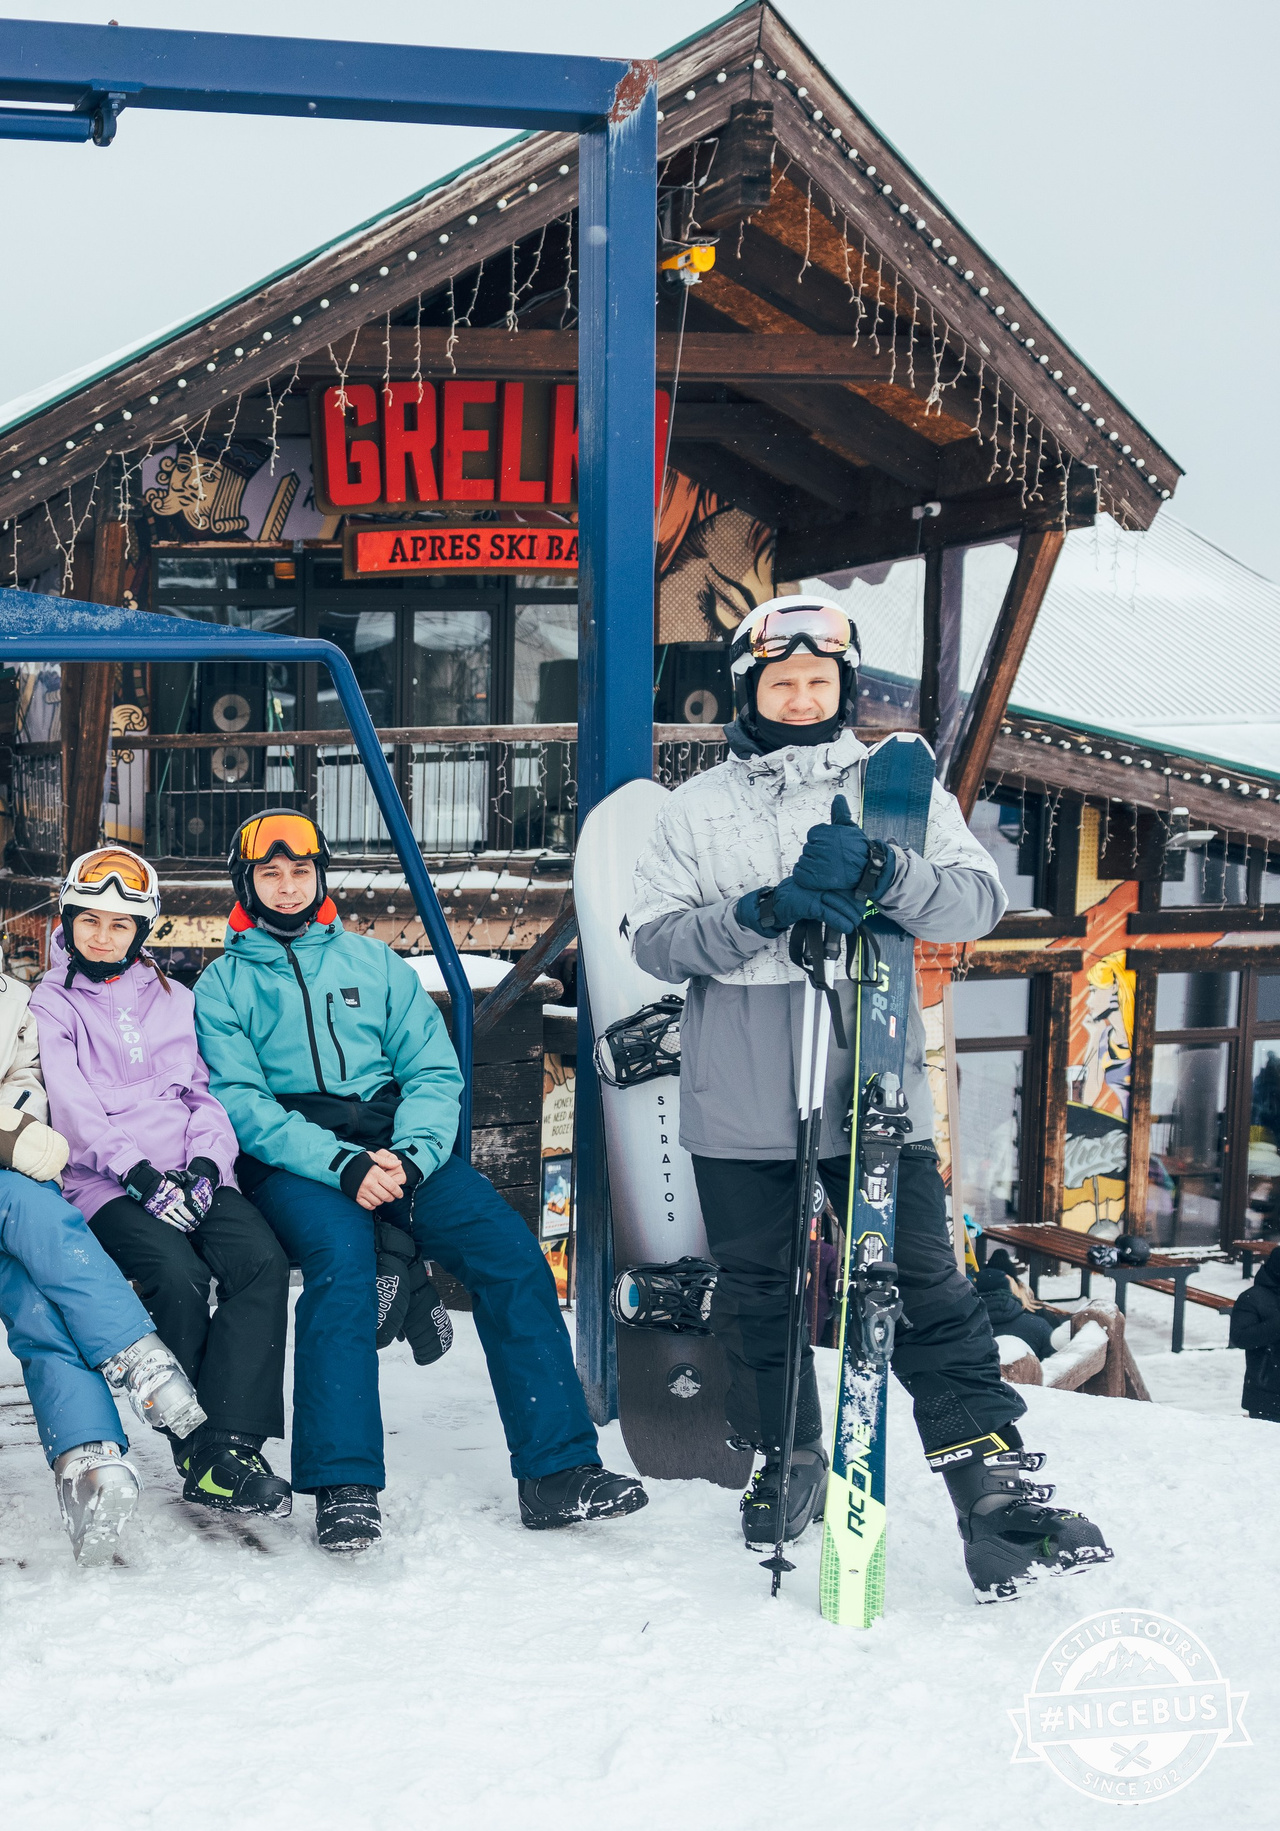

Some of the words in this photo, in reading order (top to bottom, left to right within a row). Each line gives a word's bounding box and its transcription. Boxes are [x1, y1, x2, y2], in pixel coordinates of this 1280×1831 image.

[321, 380, 671, 507] GRELK
[388, 533, 481, 563] APRES
[489, 533, 538, 560] SKI
[871, 992, 888, 1026] 78
[543, 1113, 551, 1125] WE
[553, 1111, 567, 1122] NEED
[657, 1095, 675, 1222] STRATOS
[928, 1448, 973, 1467] EAD
